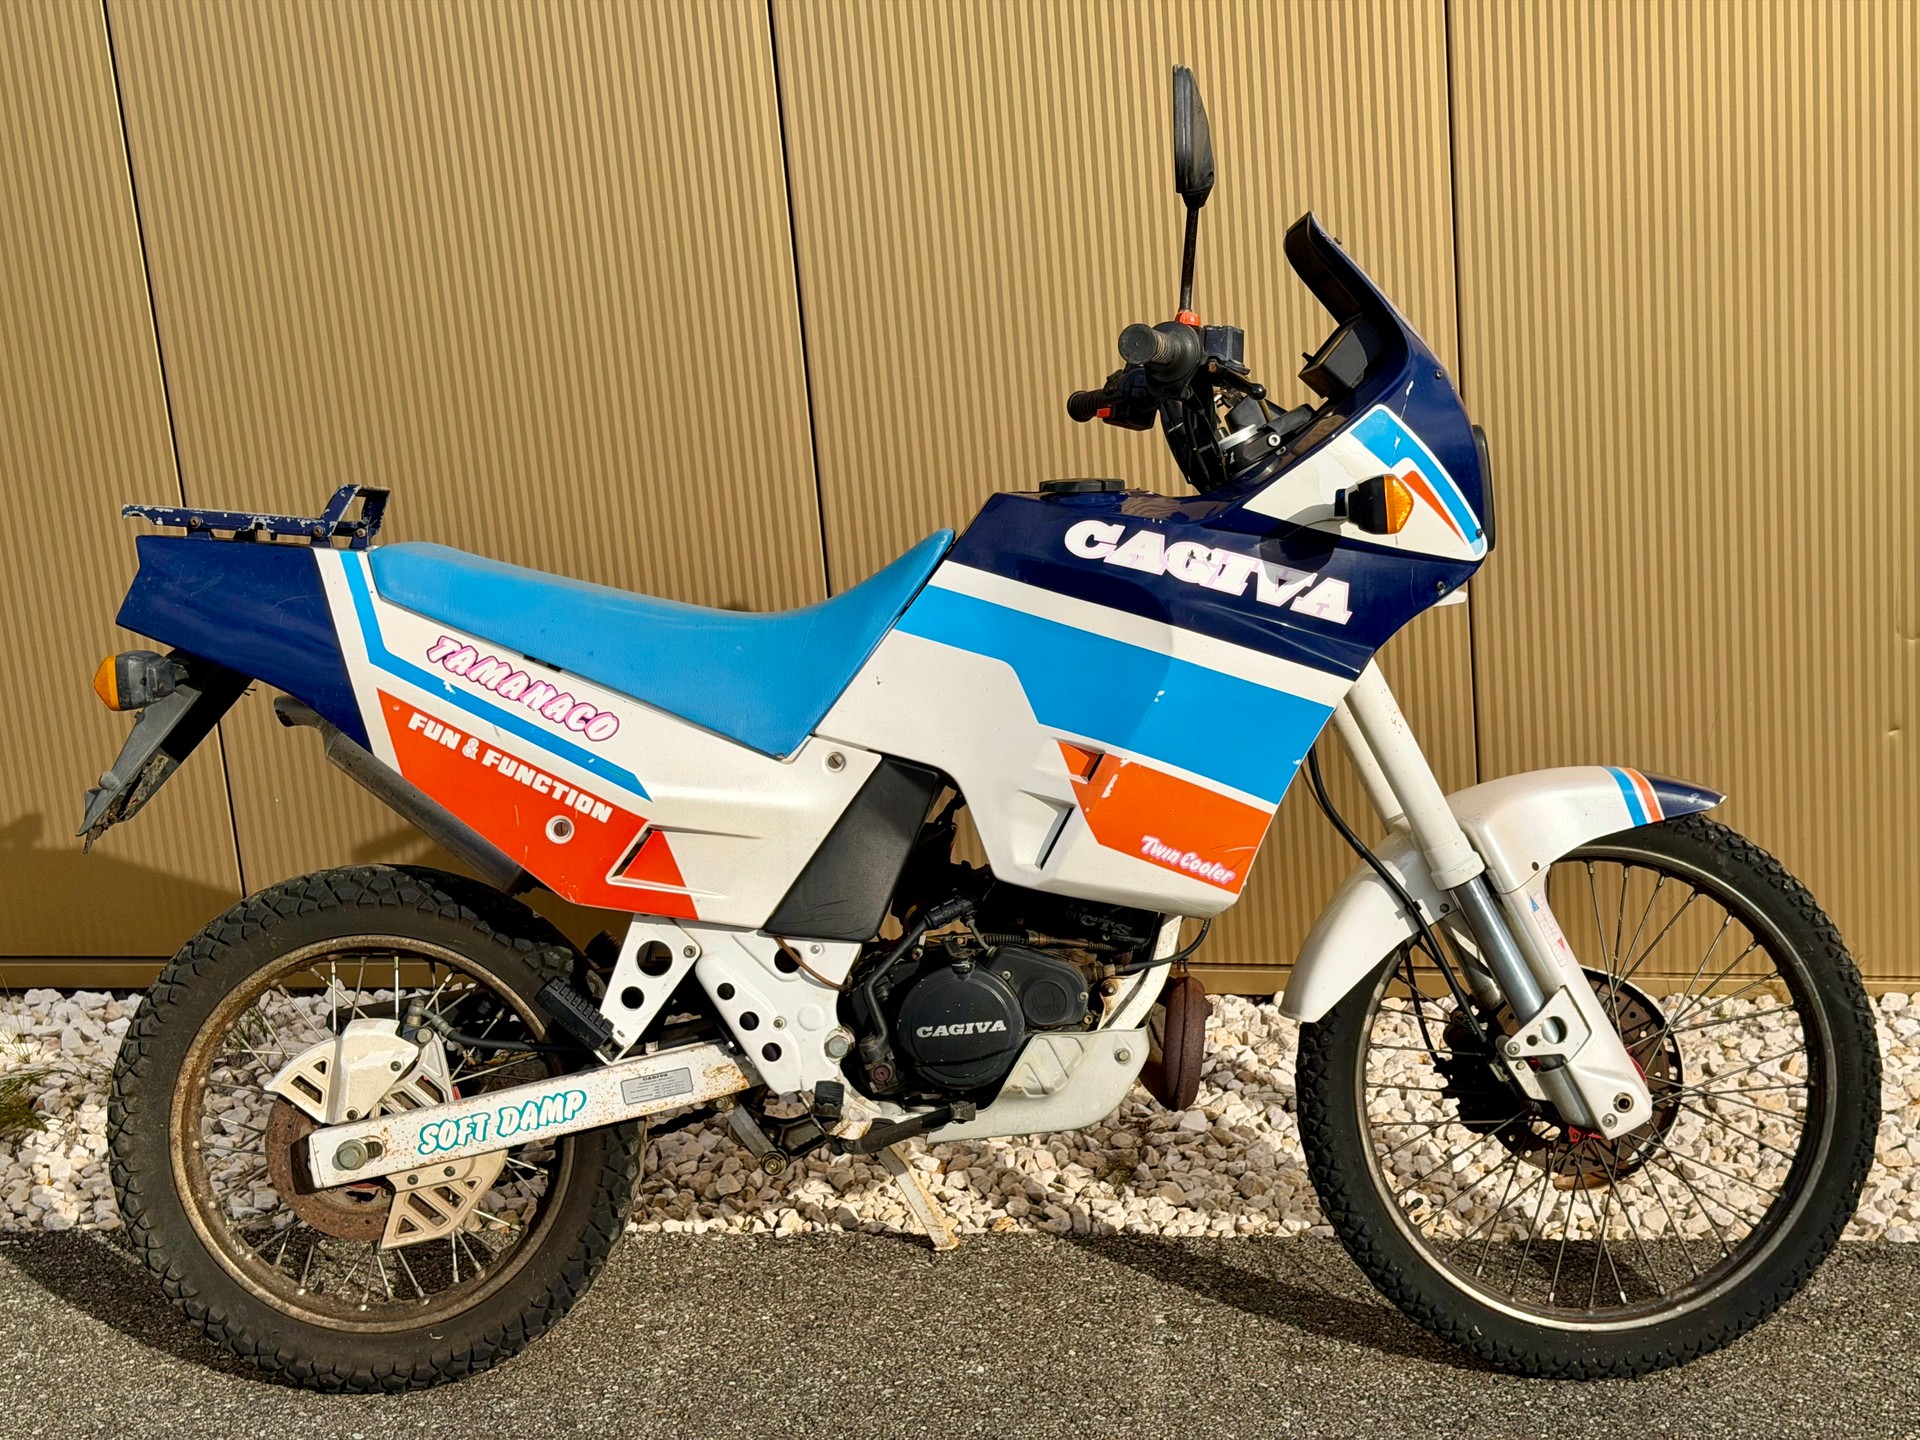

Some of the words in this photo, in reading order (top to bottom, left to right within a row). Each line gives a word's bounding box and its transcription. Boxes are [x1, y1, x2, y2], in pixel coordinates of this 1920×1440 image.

[1064, 520, 1352, 625] CAGIVA
[426, 635, 619, 742] TAMANACO
[408, 712, 461, 750] FUN
[462, 738, 479, 760] &
[481, 749, 613, 823] FUNCTION
[1141, 834, 1181, 865] Twin
[1180, 851, 1236, 884] Cooler
[1080, 914, 1133, 936] CTS
[916, 1020, 1007, 1038] CAGIVA
[418, 1112, 491, 1155] SOFT
[497, 1090, 587, 1137] DAMP
